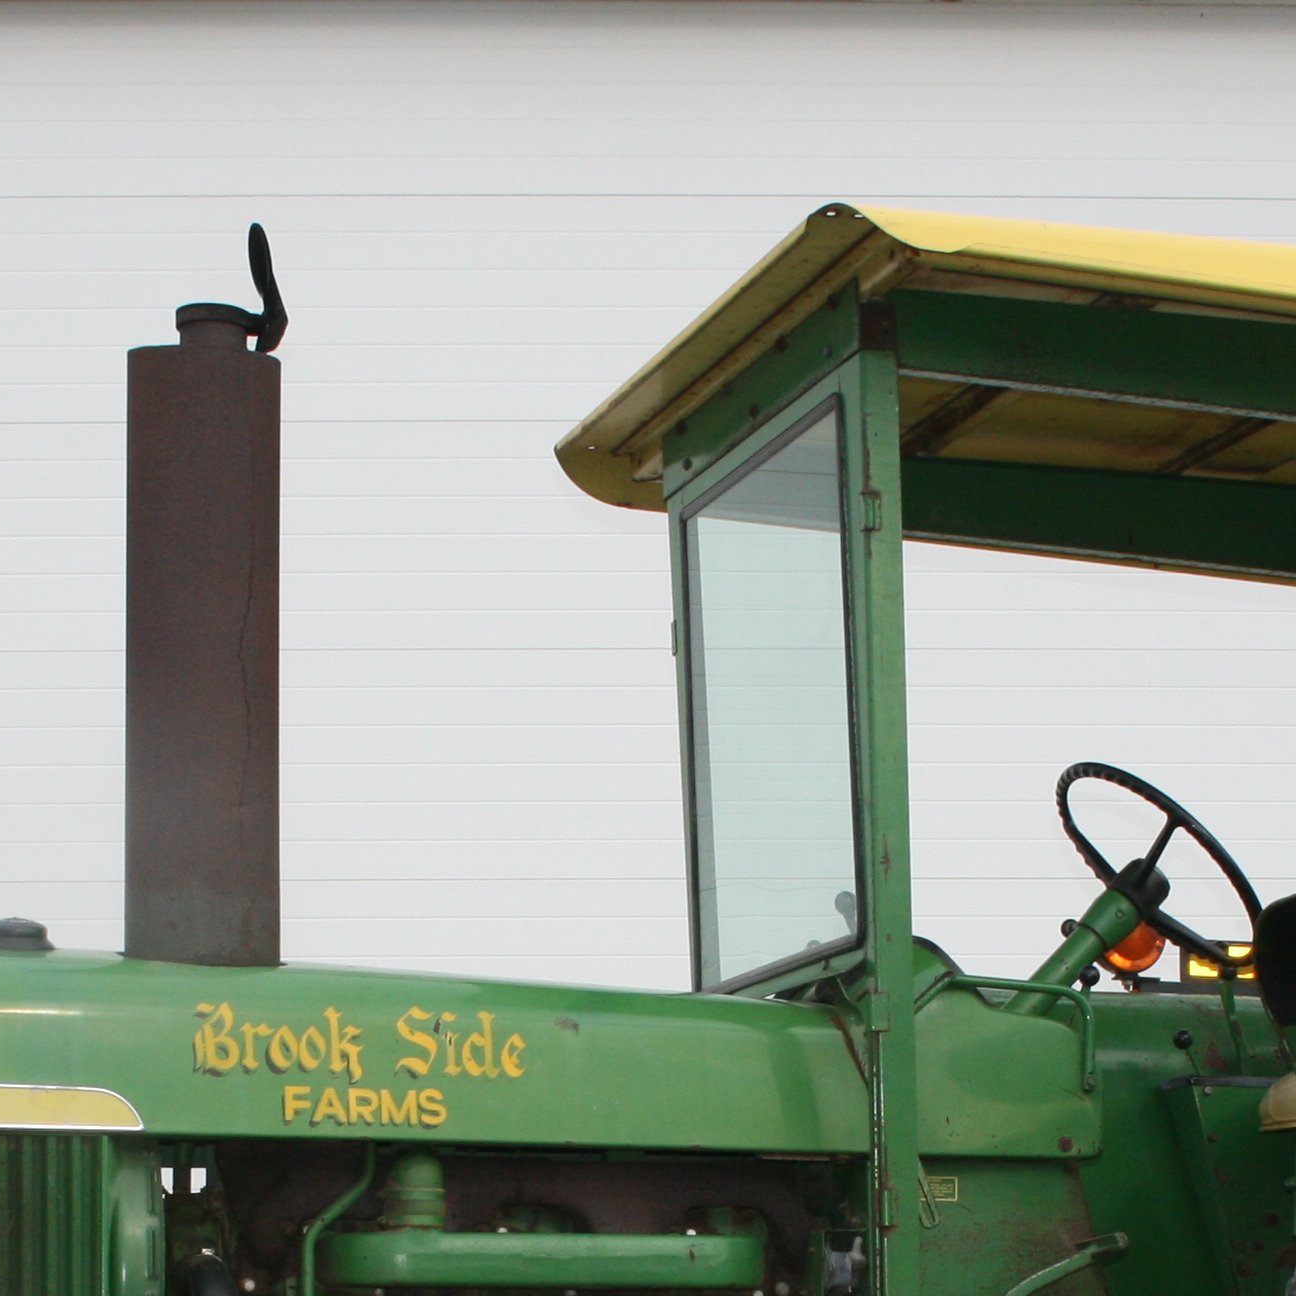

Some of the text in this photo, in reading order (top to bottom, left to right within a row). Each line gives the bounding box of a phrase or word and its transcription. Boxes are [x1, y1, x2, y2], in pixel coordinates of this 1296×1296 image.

[193, 1002, 527, 1083] Brook Side
[282, 1086, 448, 1128] FARMS
